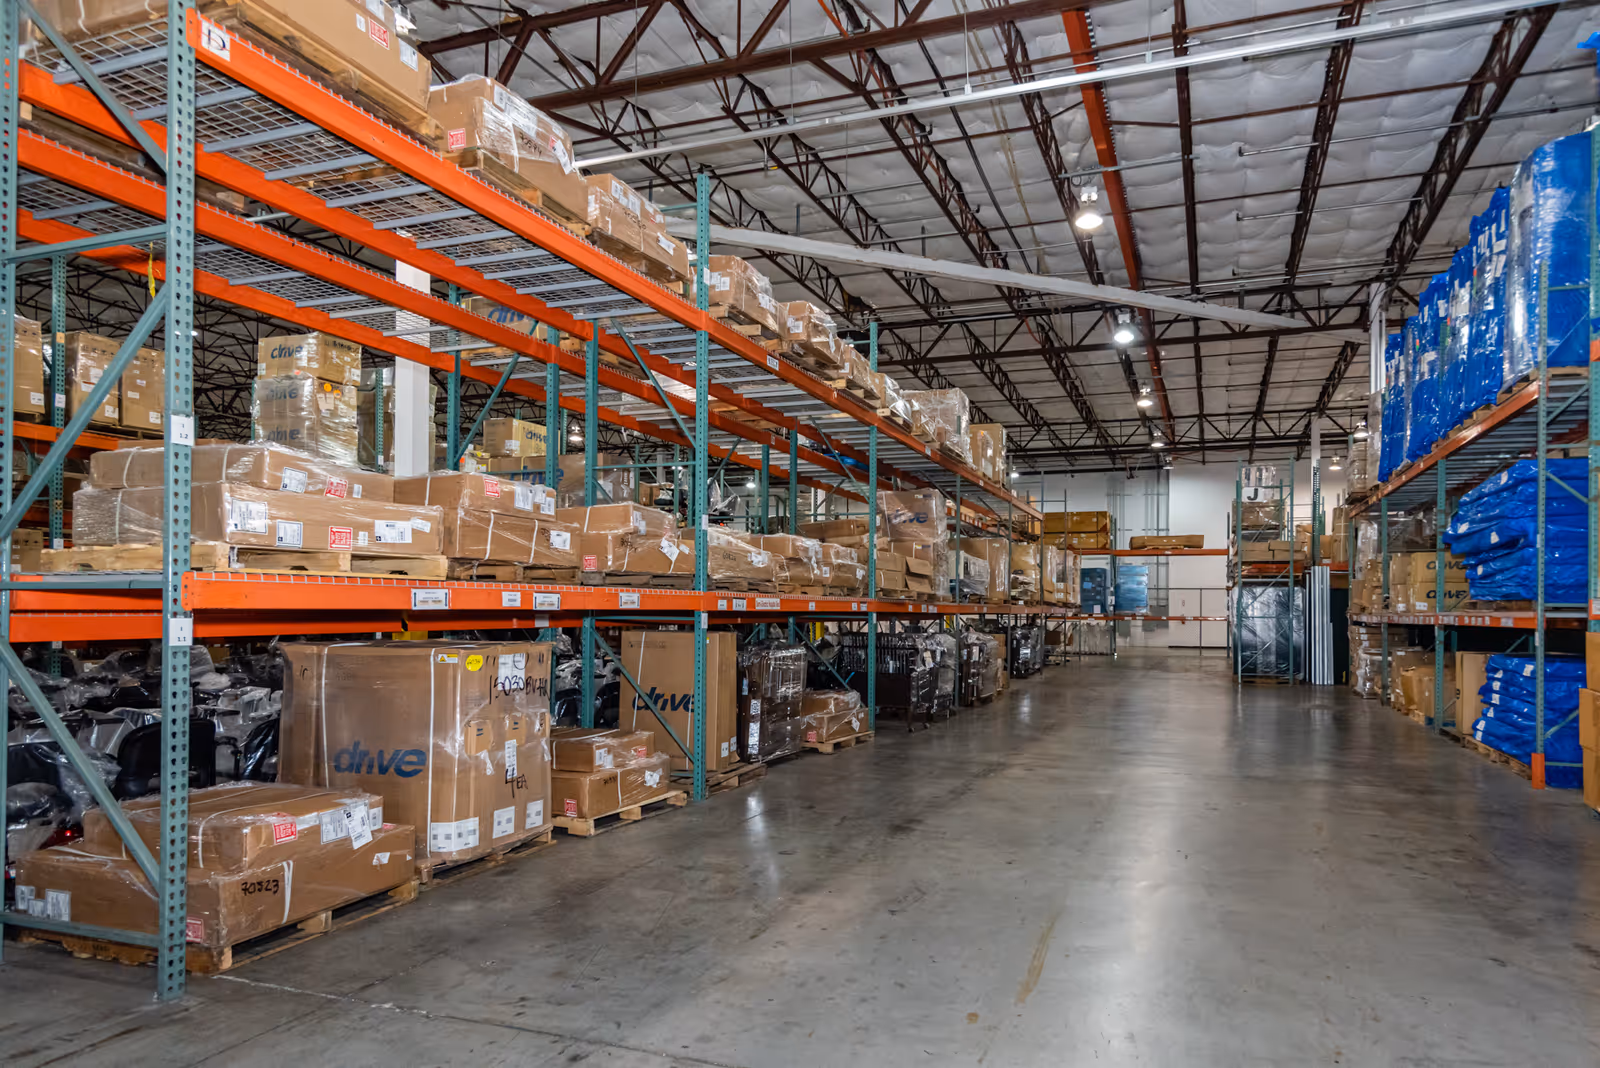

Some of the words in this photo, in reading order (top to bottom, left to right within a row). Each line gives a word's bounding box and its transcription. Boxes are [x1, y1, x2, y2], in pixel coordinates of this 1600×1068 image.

[1246, 487, 1259, 501] J
[1426, 589, 1468, 599] dive
[333, 740, 428, 778] drive
[241, 879, 279, 896] 70523
